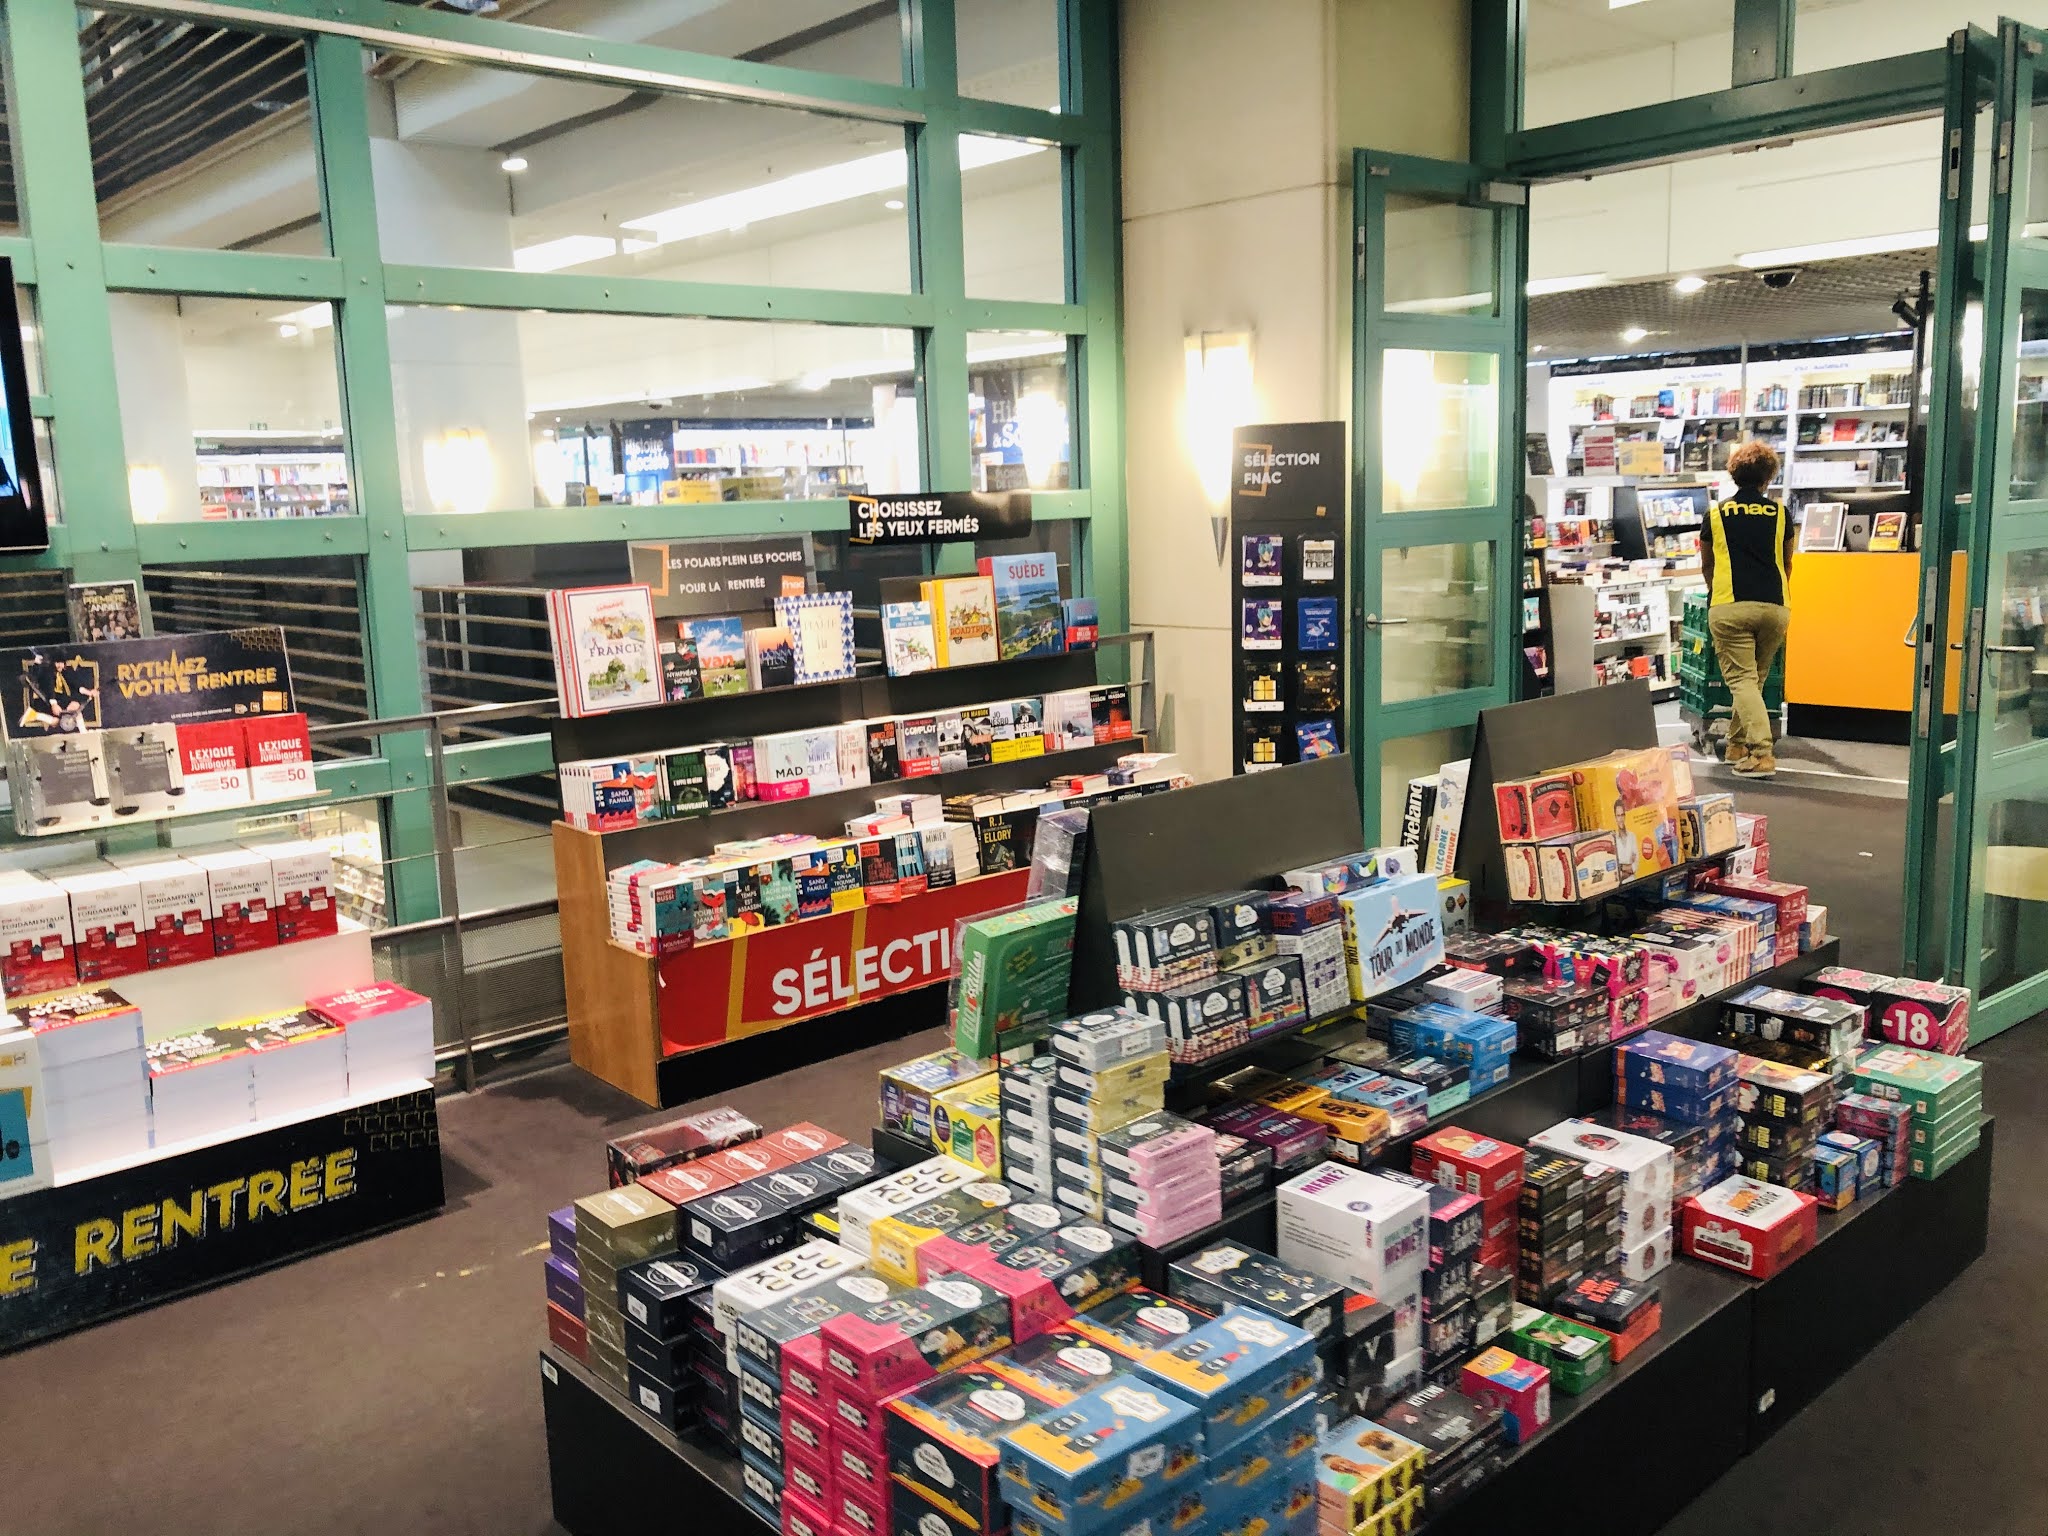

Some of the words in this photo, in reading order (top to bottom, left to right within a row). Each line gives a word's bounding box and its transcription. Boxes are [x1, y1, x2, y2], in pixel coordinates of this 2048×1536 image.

[1244, 451, 1320, 468] SÉLECTION
[1244, 470, 1282, 486] FNAC
[857, 500, 942, 519] CHOISISSEZ
[1721, 500, 1777, 517] fnac
[859, 521, 884, 539] LES
[887, 519, 924, 537] YEUX
[928, 514, 980, 536] FERMÉS
[684, 555, 721, 568] POLARS
[722, 554, 746, 566] PLEIN
[749, 552, 763, 565] LES
[765, 550, 802, 563] POCHES
[1008, 561, 1046, 580] SUÈDE
[680, 582, 706, 594] POUR
[708, 581, 721, 592] LA
[728, 576, 766, 590] RENTRÉE
[118, 678, 191, 700] VOTRE
[196, 666, 278, 691] RENTRÉE
[905, 724, 937, 736] COMPLOT
[189, 745, 235, 761] LEXIQUE
[259, 737, 303, 753] LEXIQUE
[190, 758, 237, 772] JURIDIQUES
[260, 750, 304, 764] JURIDIQUES
[287, 768, 307, 782] 50
[775, 766, 803, 779] MAD
[220, 775, 240, 790] 50
[608, 795, 633, 805] FAMILLE
[610, 789, 629, 799] SANG
[676, 799, 709, 812] NOUVEAUTÉ
[984, 828, 1012, 844] ELLORY
[1435, 828, 1449, 871] LICORNE
[807, 884, 828, 893] FAMILLE
[808, 878, 826, 887] SANG
[147, 891, 204, 905] FONDAMENTAUX
[656, 894, 675, 903] BUSSI
[740, 891, 757, 899] TEMPS
[737, 903, 762, 914] ASSASSIN
[1346, 945, 1359, 966] TOUR
[1369, 945, 1394, 979] TOUR
[1405, 917, 1435, 957] MONDE
[1881, 1009, 1930, 1047] -18
[1300, 1168, 1350, 1194] MEME?
[73, 1146, 358, 1276] RENTRÉE
